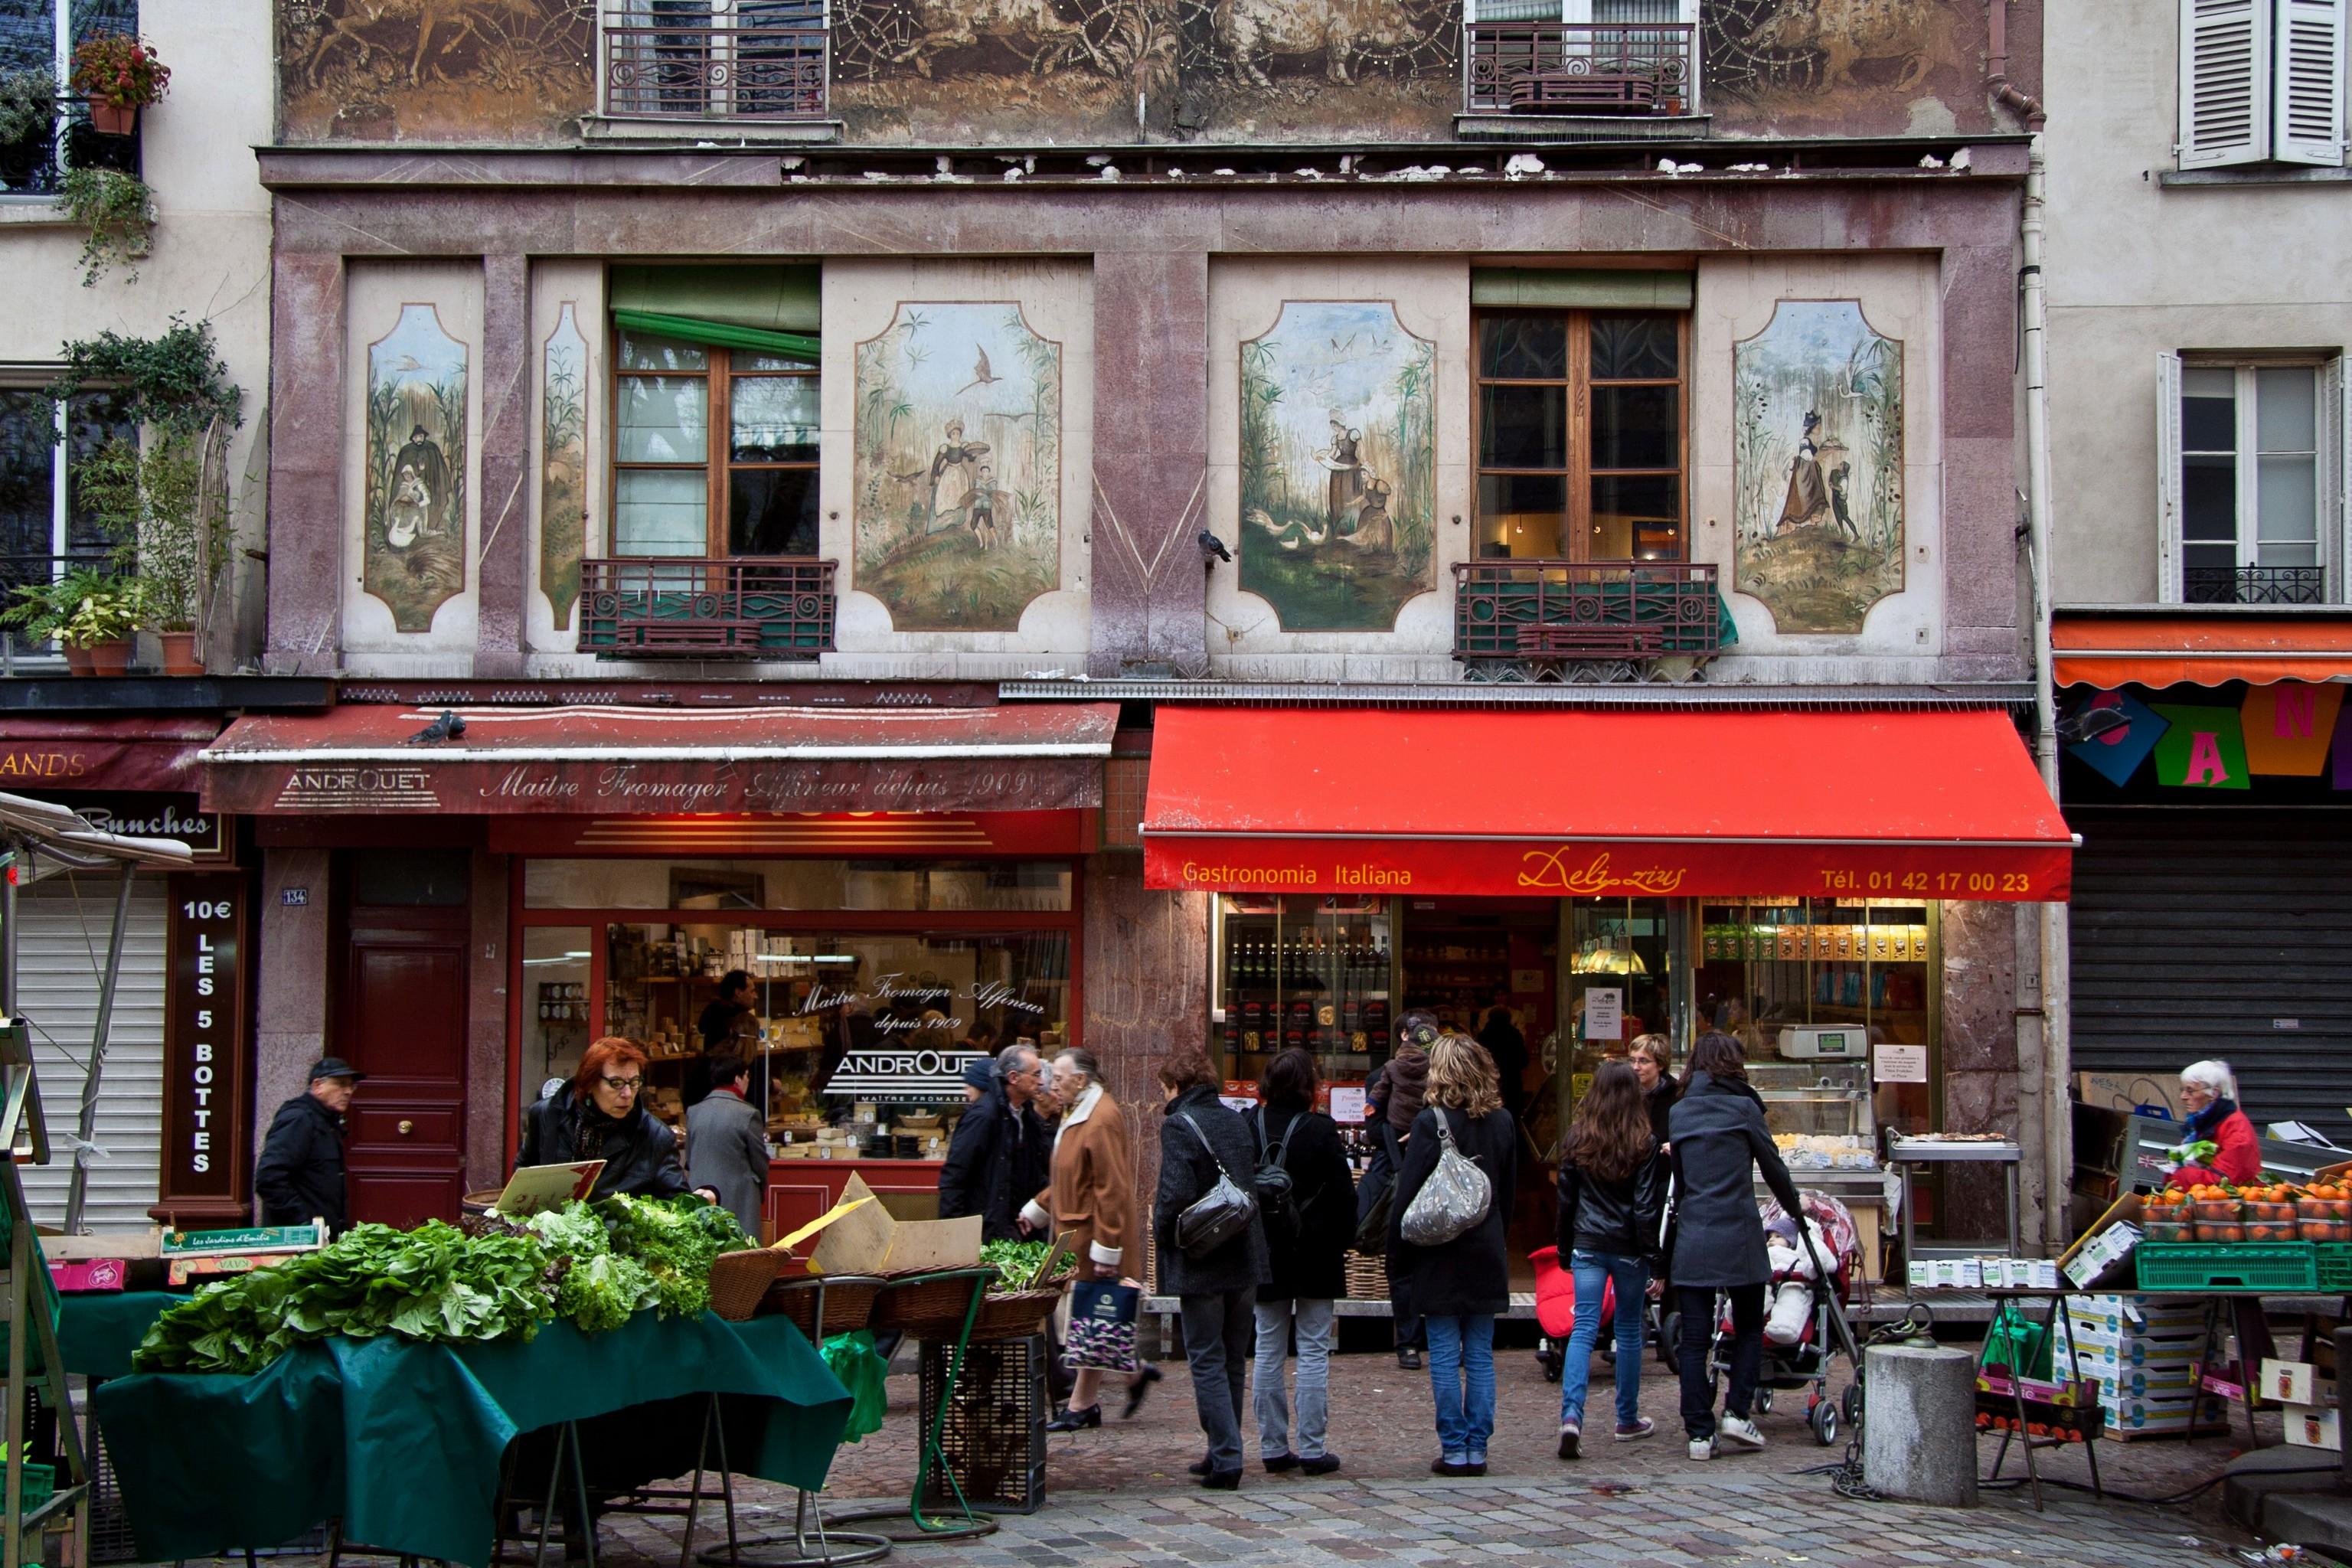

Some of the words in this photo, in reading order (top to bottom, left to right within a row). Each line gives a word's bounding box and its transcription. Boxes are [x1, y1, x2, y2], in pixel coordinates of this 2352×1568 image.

[0, 753, 86, 776] ANDS
[286, 768, 430, 792] ANDROUET
[479, 766, 579, 797] Maître
[597, 764, 727, 810] Fromager
[743, 769, 861, 809] Affineur
[874, 769, 950, 808] depuis
[74, 805, 211, 834] Bunches
[1182, 862, 1317, 884] Gastronomia
[1335, 864, 1411, 885] Italiana
[1821, 870, 1860, 889] Tél.
[1868, 871, 1893, 890] 01
[1901, 872, 1928, 890] 42
[1936, 873, 1962, 891] 17
[1968, 873, 1995, 892] 00
[2002, 874, 2029, 892] 23
[286, 890, 305, 903] 134
[184, 901, 231, 920] 10€
[198, 934, 214, 996] LES
[792, 984, 857, 1018] Maître
[867, 971, 952, 1004] Fromager
[959, 979, 1046, 1015] Affineur
[197, 1010, 212, 1028] 5
[874, 1013, 922, 1035] depuis
[926, 1018, 962, 1030] 1909
[835, 1050, 996, 1075] ANDROUE
[193, 1044, 213, 1173] BOTTES
